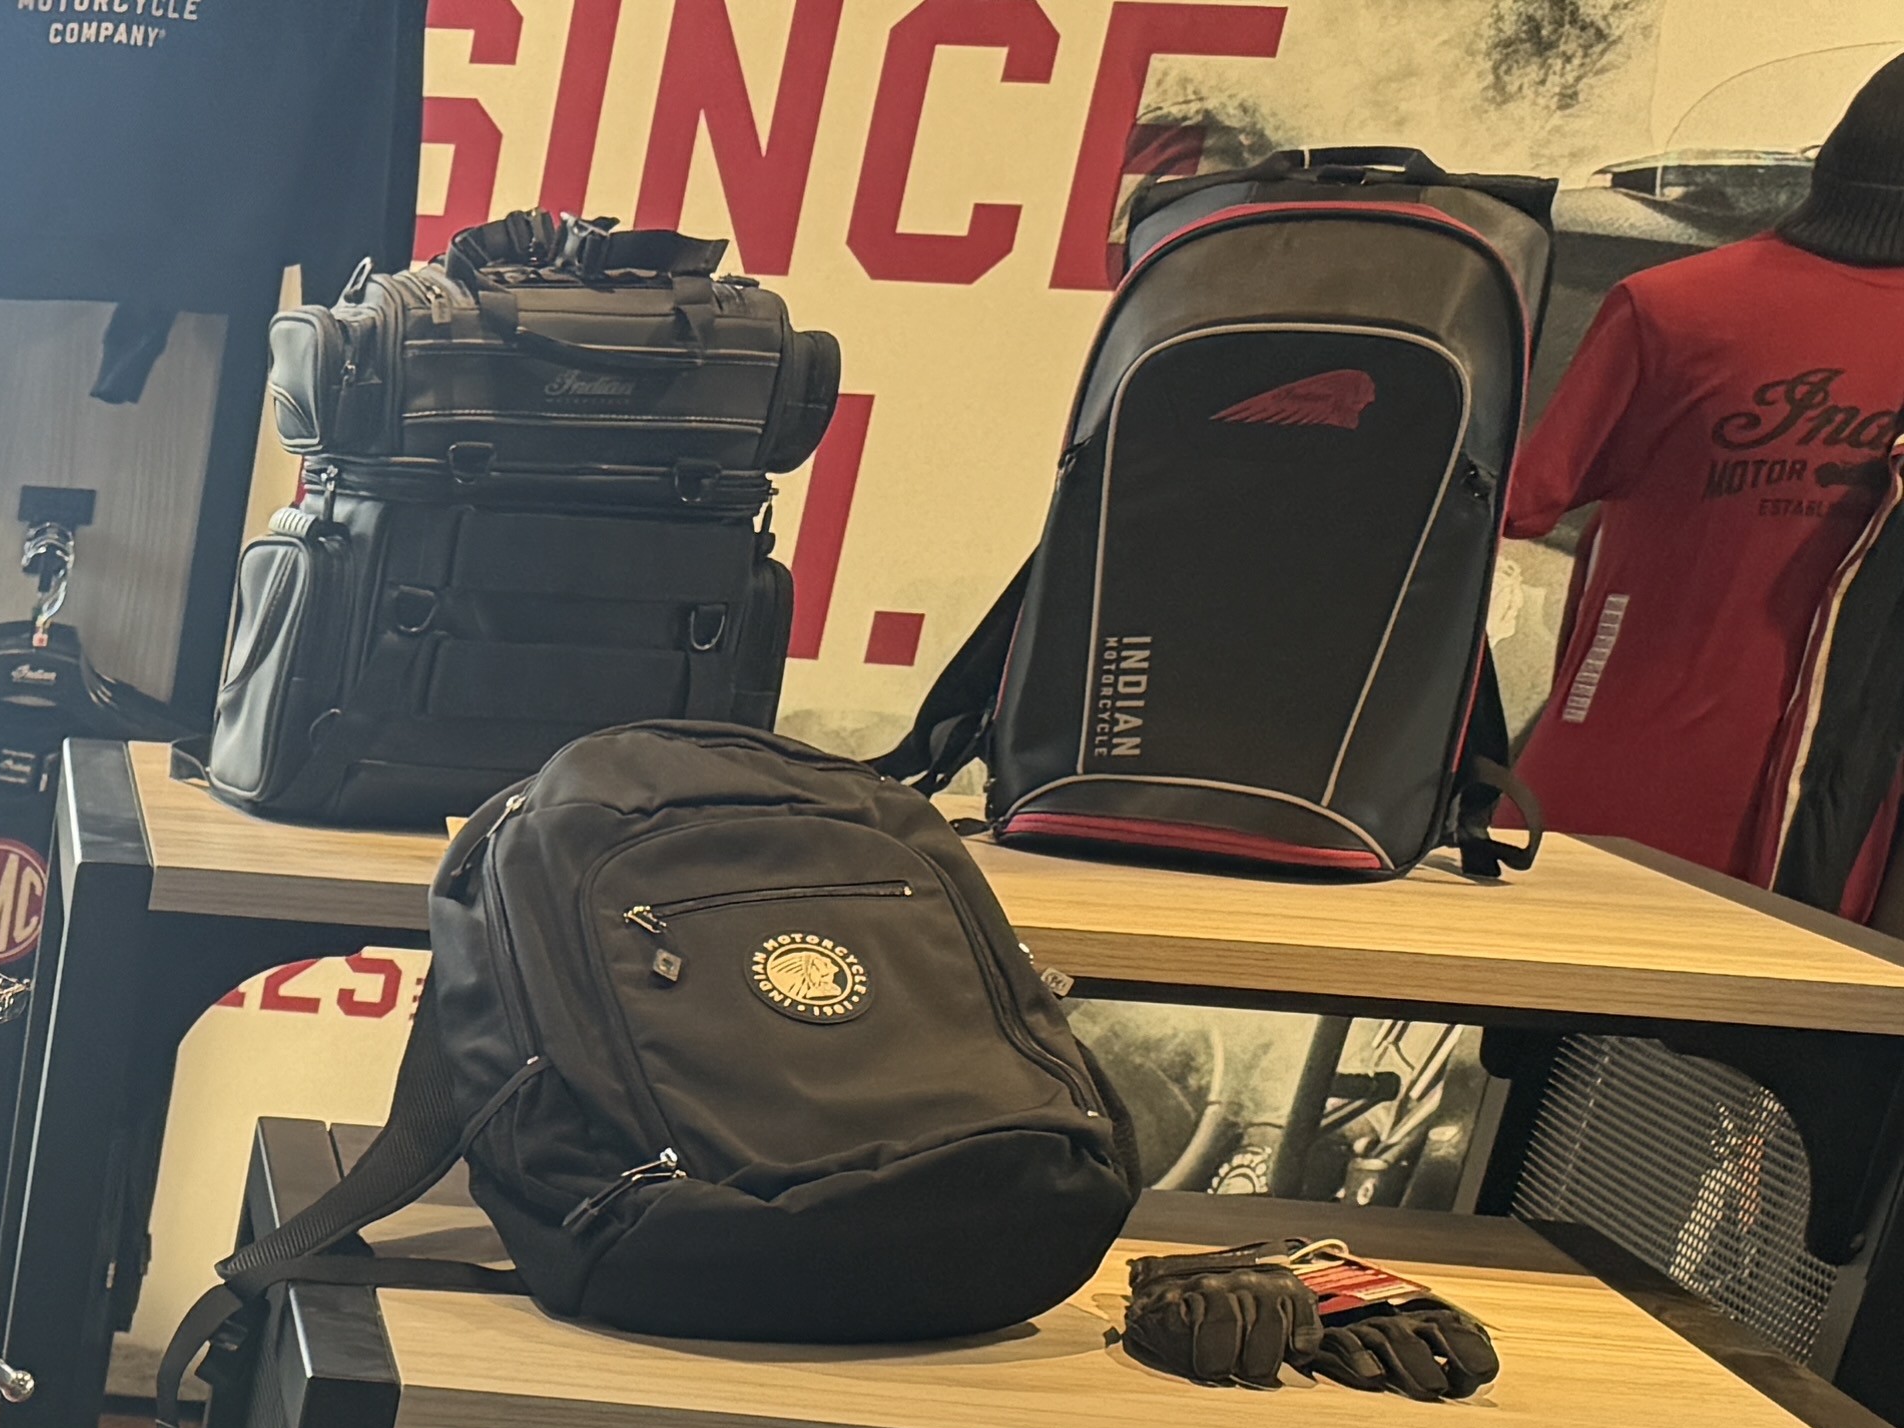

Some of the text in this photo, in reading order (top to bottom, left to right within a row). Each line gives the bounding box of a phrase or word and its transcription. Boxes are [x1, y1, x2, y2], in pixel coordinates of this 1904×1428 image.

[49, 21, 160, 48] COMPANY
[413, 0, 1288, 290] SINCE
[1095, 636, 1119, 757] MOTORCYCLE
[1111, 636, 1152, 757] INDIAN
[752, 932, 867, 1007] INDIAN MOTORCYCLE
